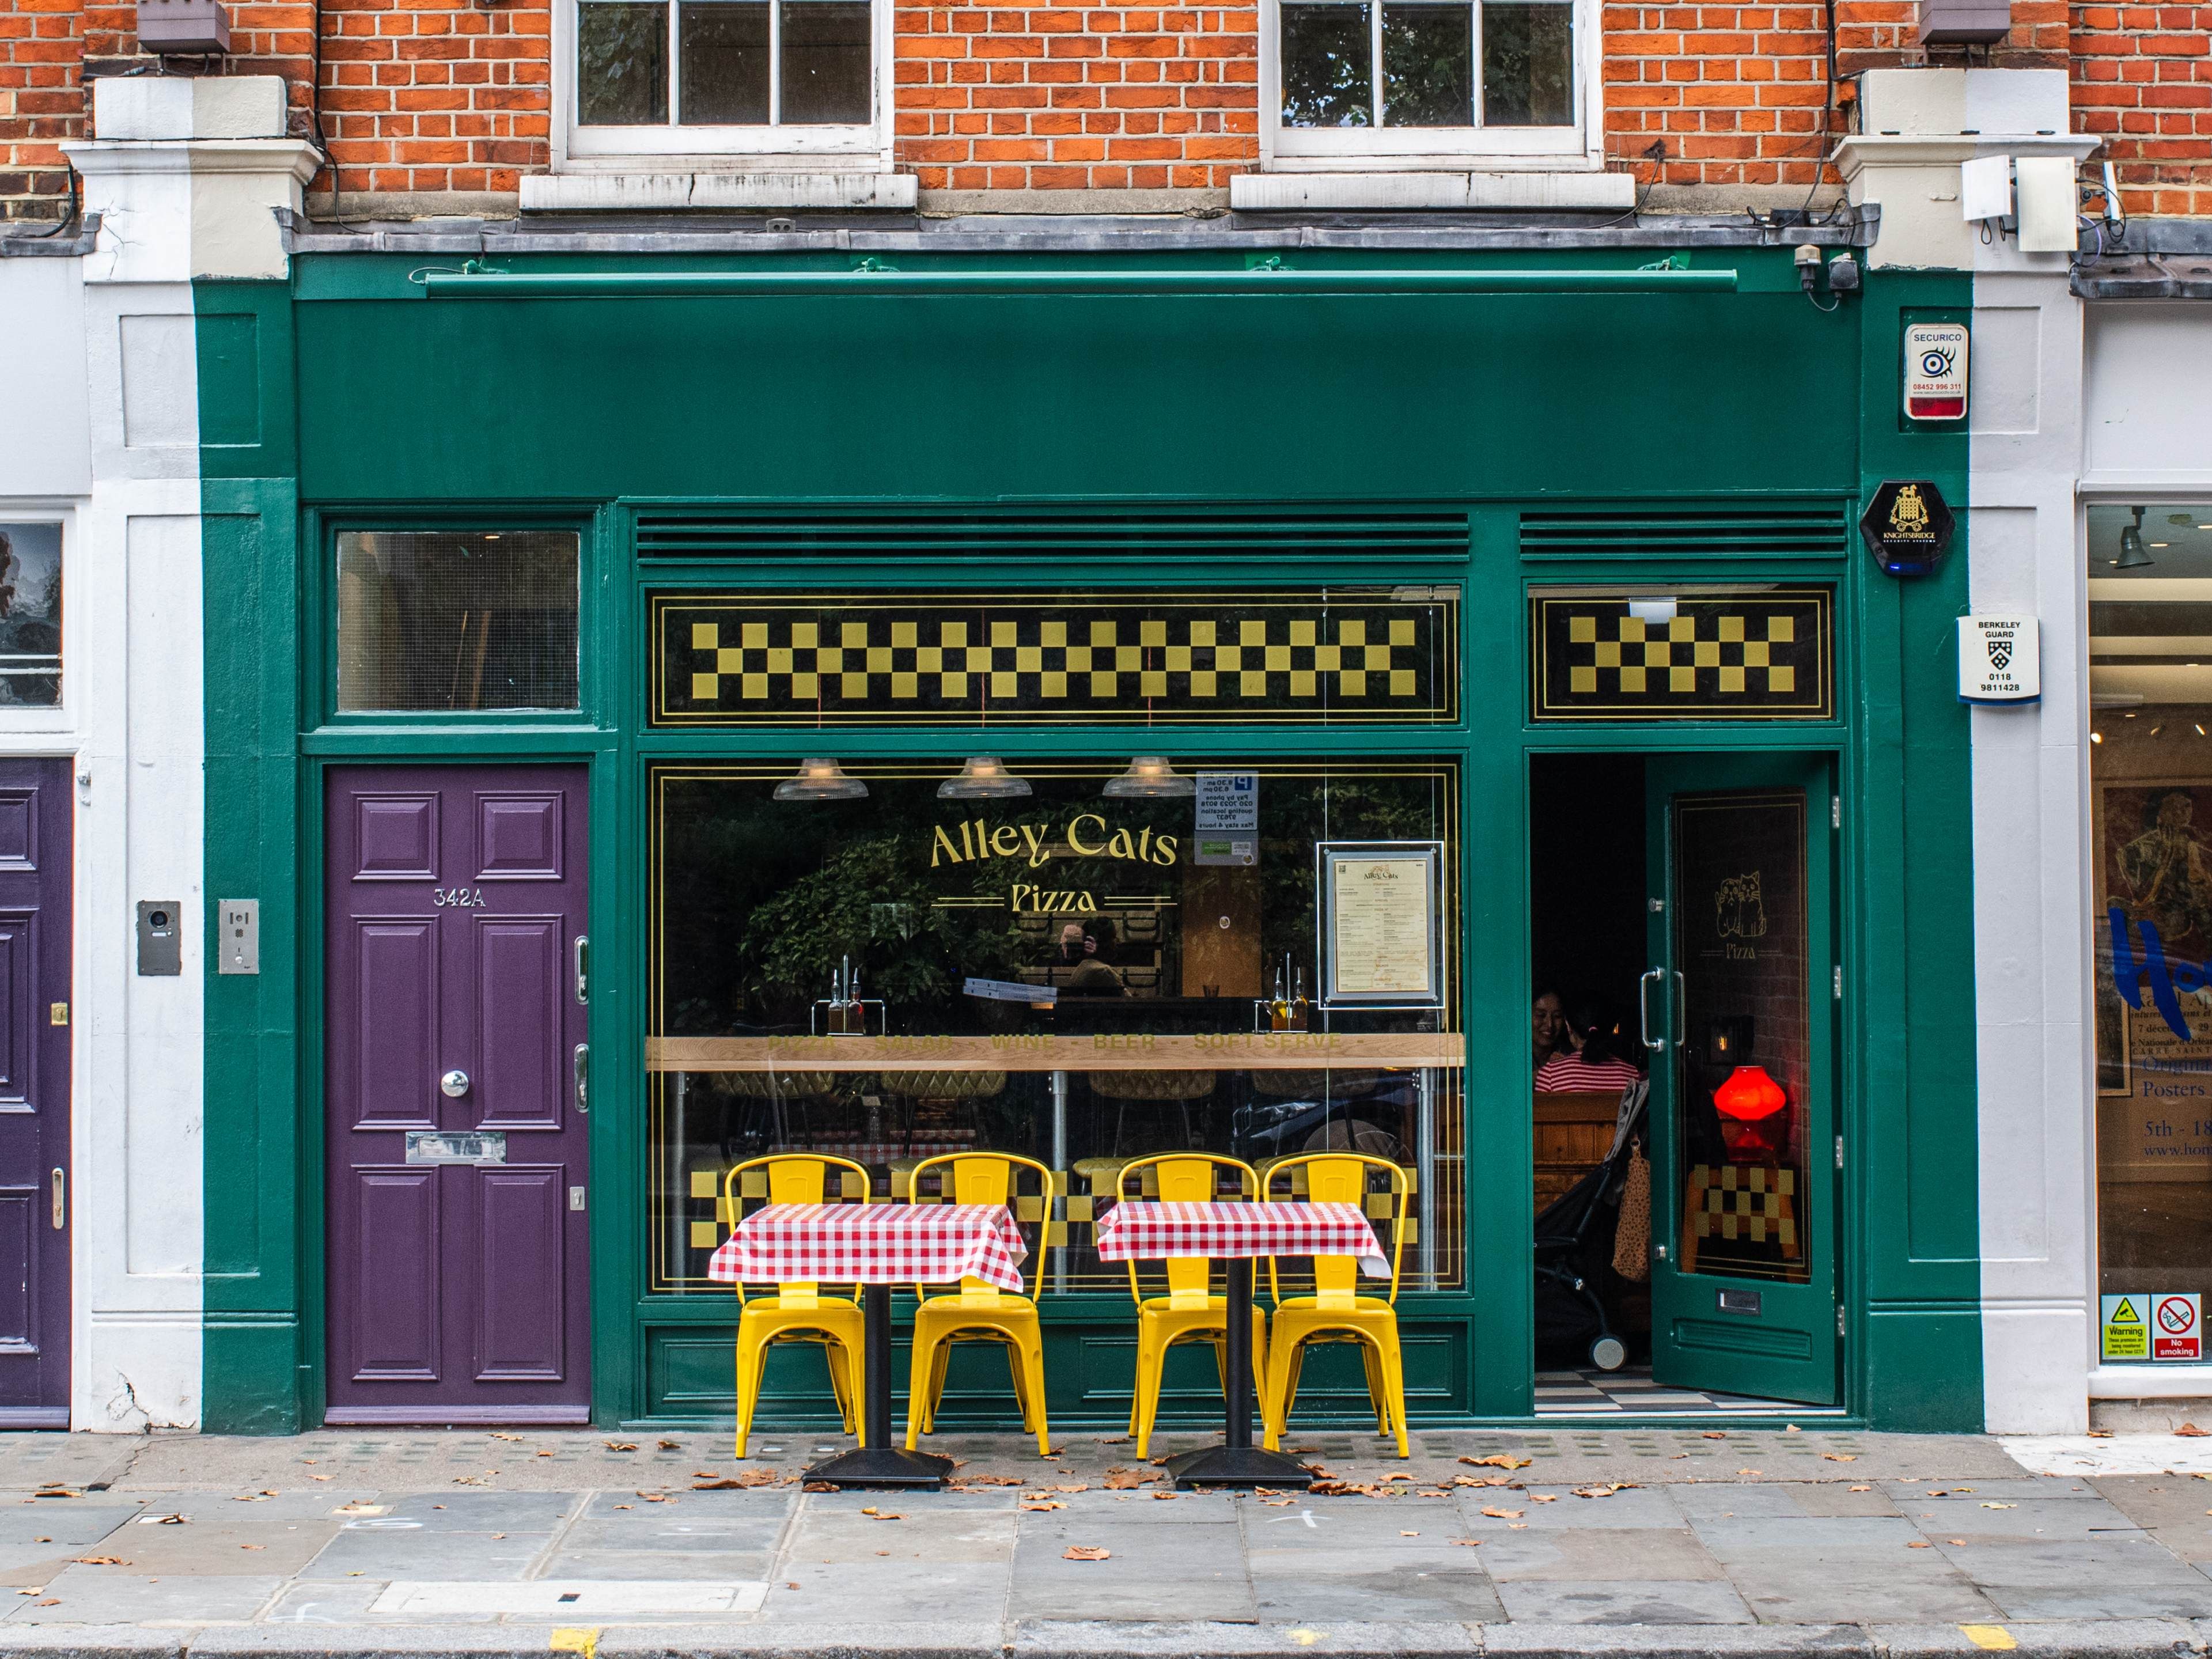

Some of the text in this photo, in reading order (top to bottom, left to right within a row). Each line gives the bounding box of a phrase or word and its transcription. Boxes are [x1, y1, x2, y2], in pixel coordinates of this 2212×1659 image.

[931, 814, 1177, 868] Alley Cats
[434, 888, 486, 907] 342A
[1012, 885, 1097, 912] Pizza
[1726, 943, 1756, 959] Pizza
[768, 1035, 837, 1051] PIZZA
[875, 1035, 953, 1051] SALAD
[991, 1034, 1055, 1051] WINE
[1094, 1034, 1156, 1050] BEER
[1194, 1033, 1253, 1050] SOFT
[1263, 1032, 1342, 1050] SERVE
[2143, 1081, 2205, 1097] Posters
[2144, 1120, 2172, 1137] 5th
[2109, 1326, 2143, 1337] Warning
[2160, 1348, 2194, 1356] smoking
